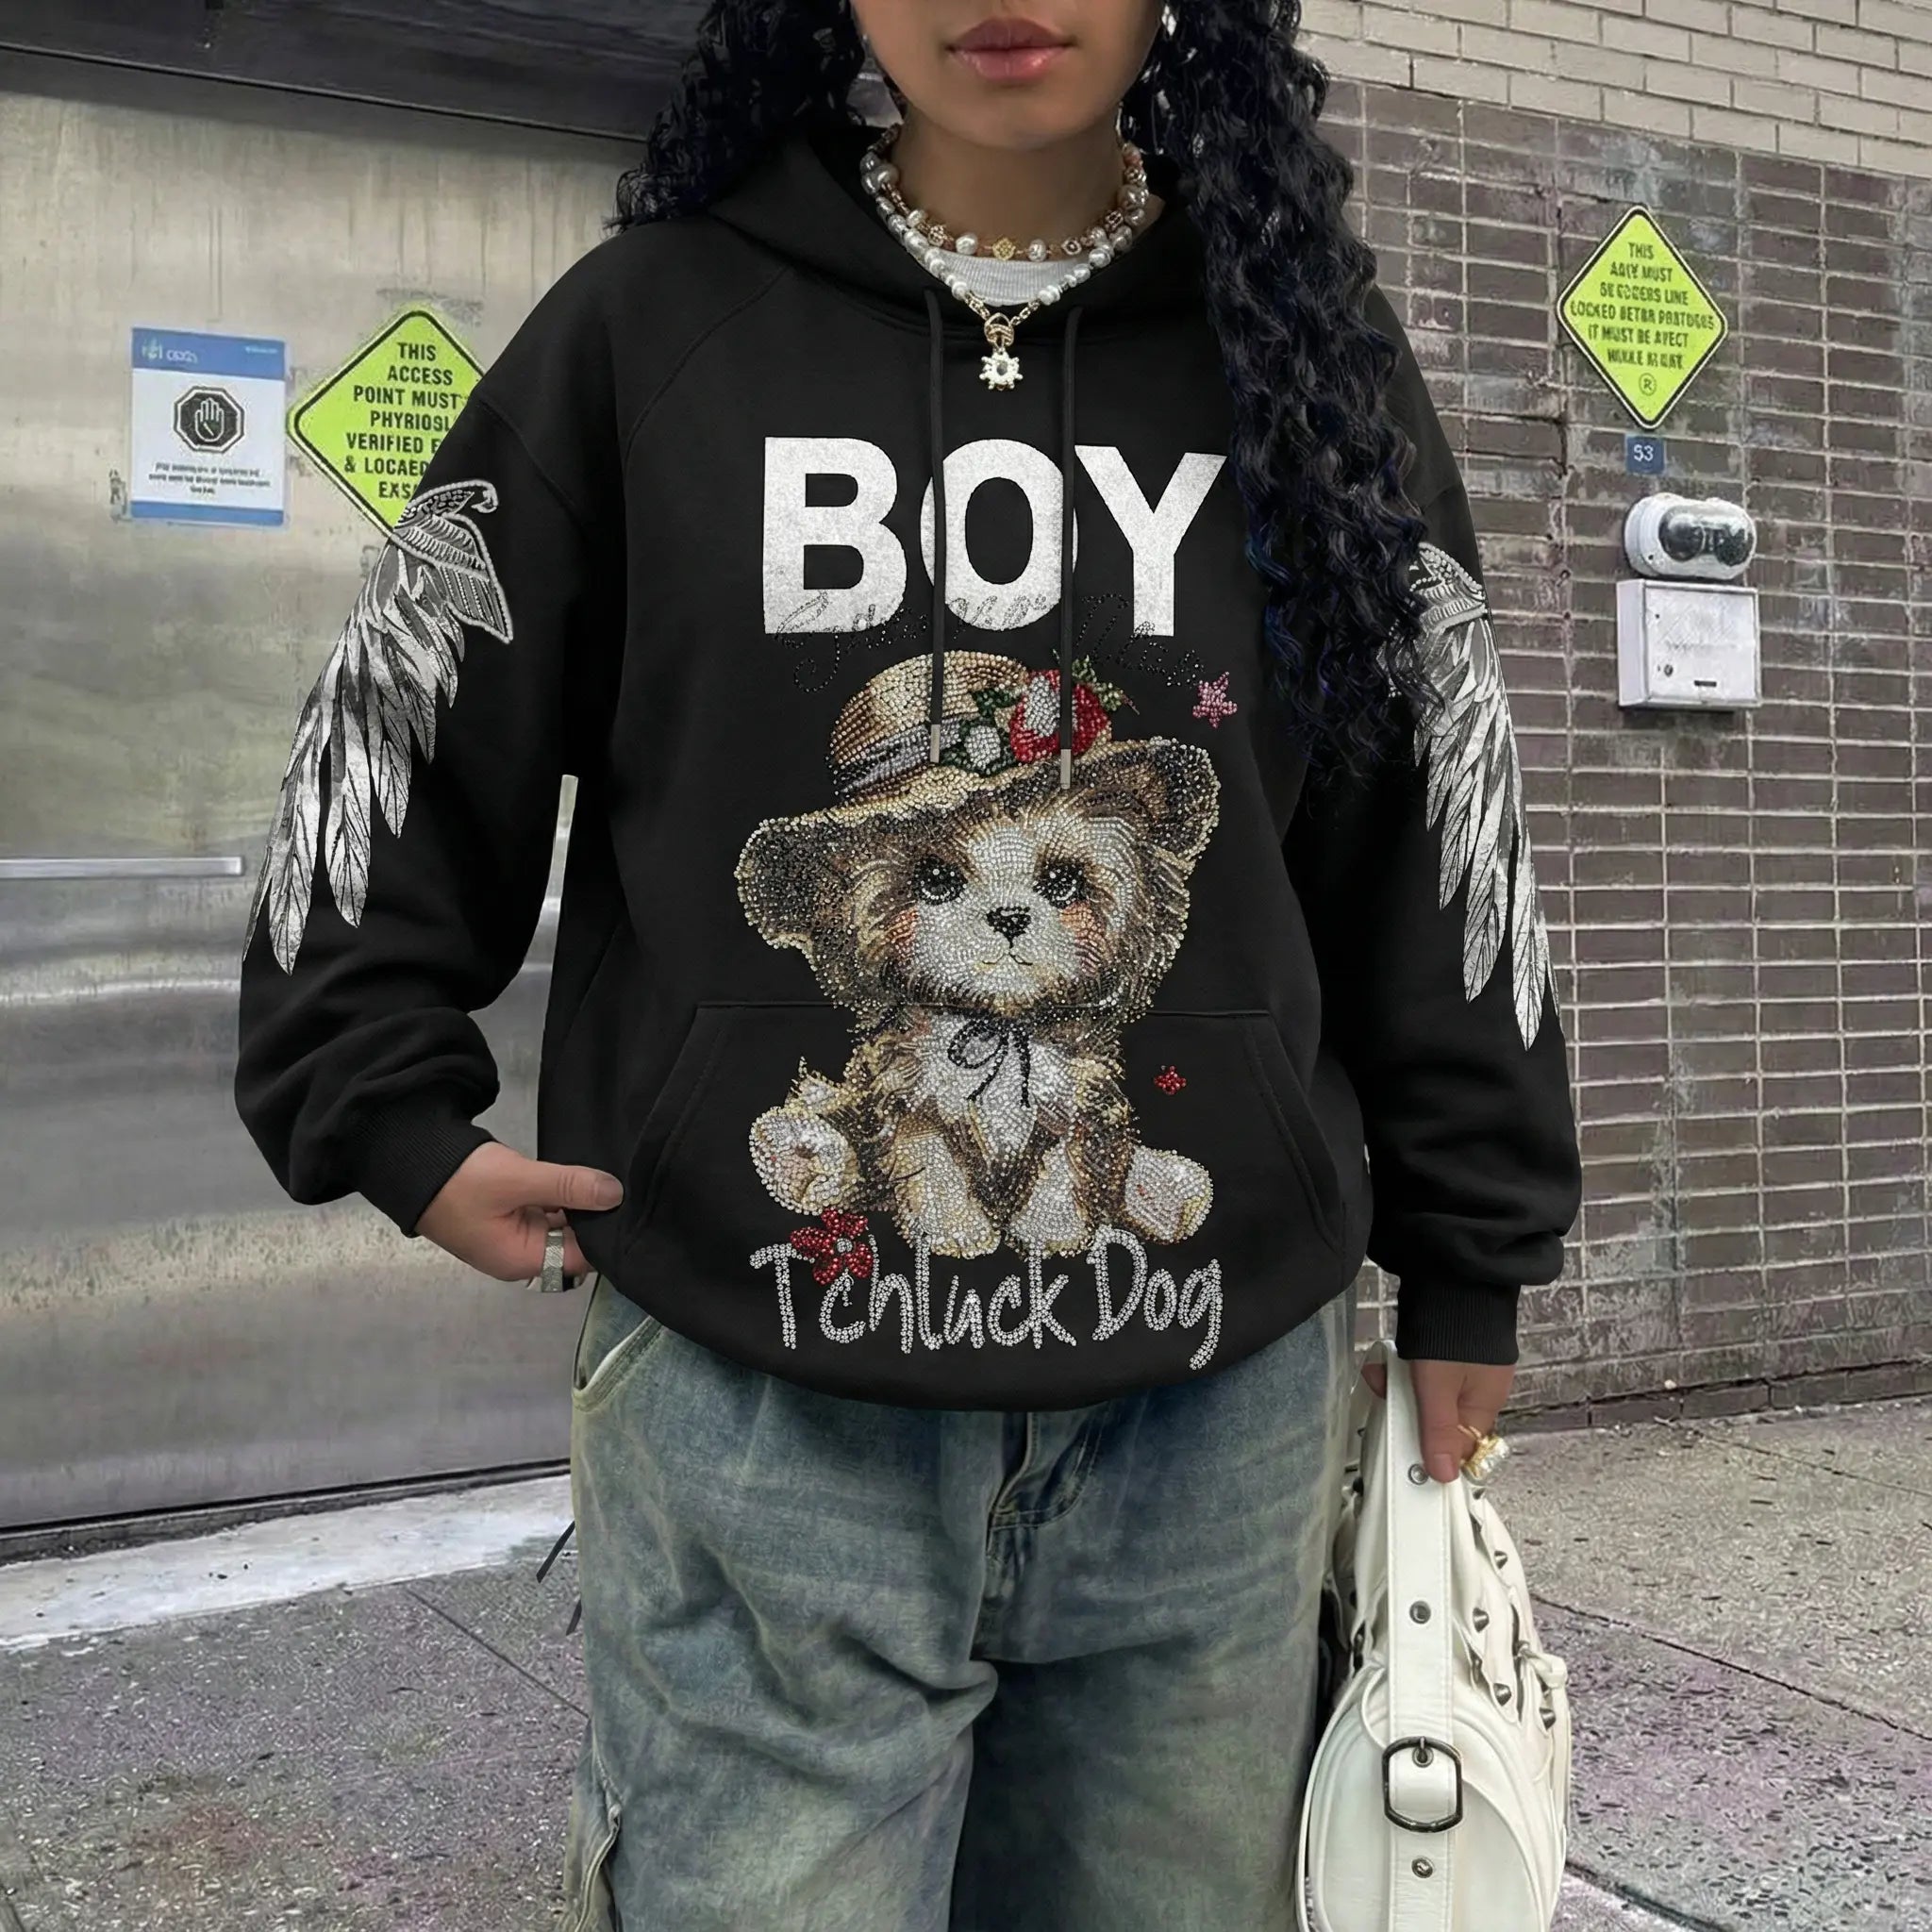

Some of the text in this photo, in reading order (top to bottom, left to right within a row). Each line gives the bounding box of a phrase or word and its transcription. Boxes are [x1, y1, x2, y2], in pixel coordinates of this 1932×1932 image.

[1628, 242, 1654, 259] THIS
[397, 342, 437, 361] THIS
[388, 366, 454, 385] ACCESS
[354, 385, 459, 409] POINT MUST
[371, 410, 453, 432] PHYRIOSL
[346, 433, 424, 454] VERIFIED
[343, 456, 357, 473] &
[378, 481, 415, 499] EXS
[762, 436, 1227, 637] BOY
[1086, 1225, 1224, 1371] Dog
